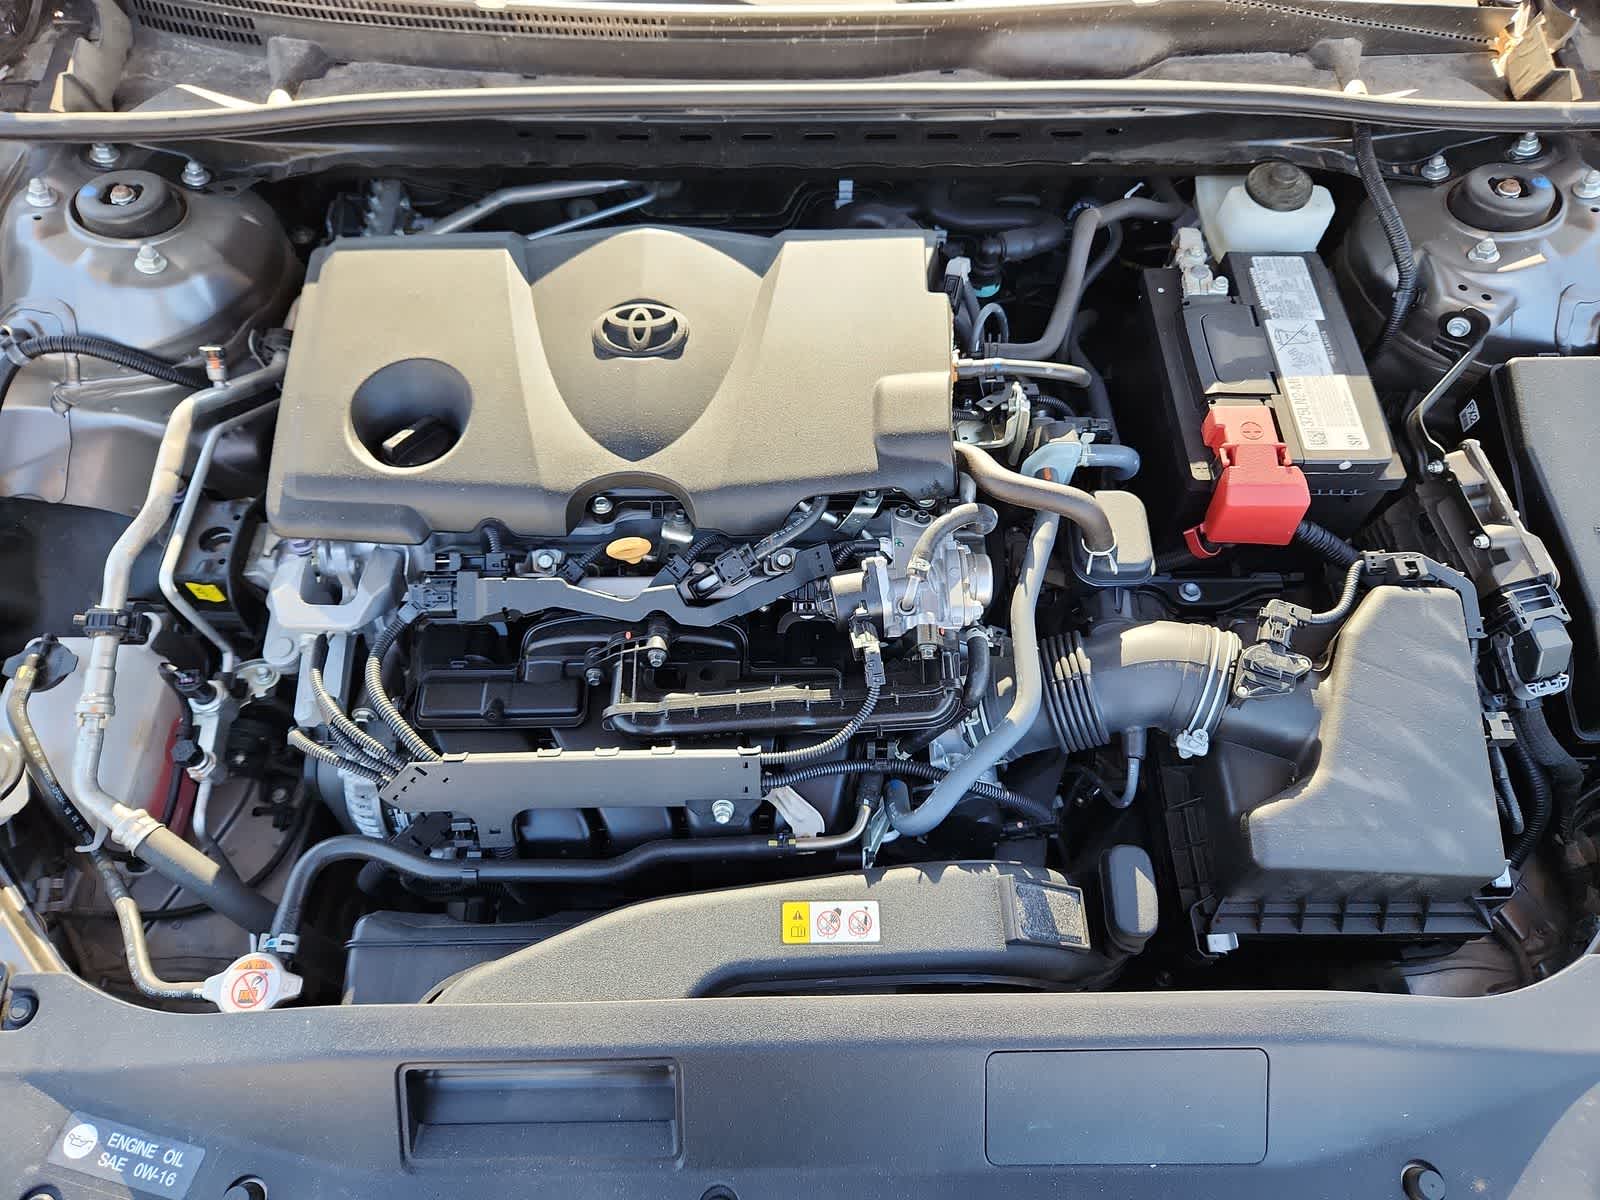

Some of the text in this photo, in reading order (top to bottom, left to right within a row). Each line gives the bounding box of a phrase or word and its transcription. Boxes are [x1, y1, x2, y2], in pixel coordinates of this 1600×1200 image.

[107, 1133, 184, 1168] ENGINE OIL
[98, 1152, 177, 1187] SAE 0W-16
